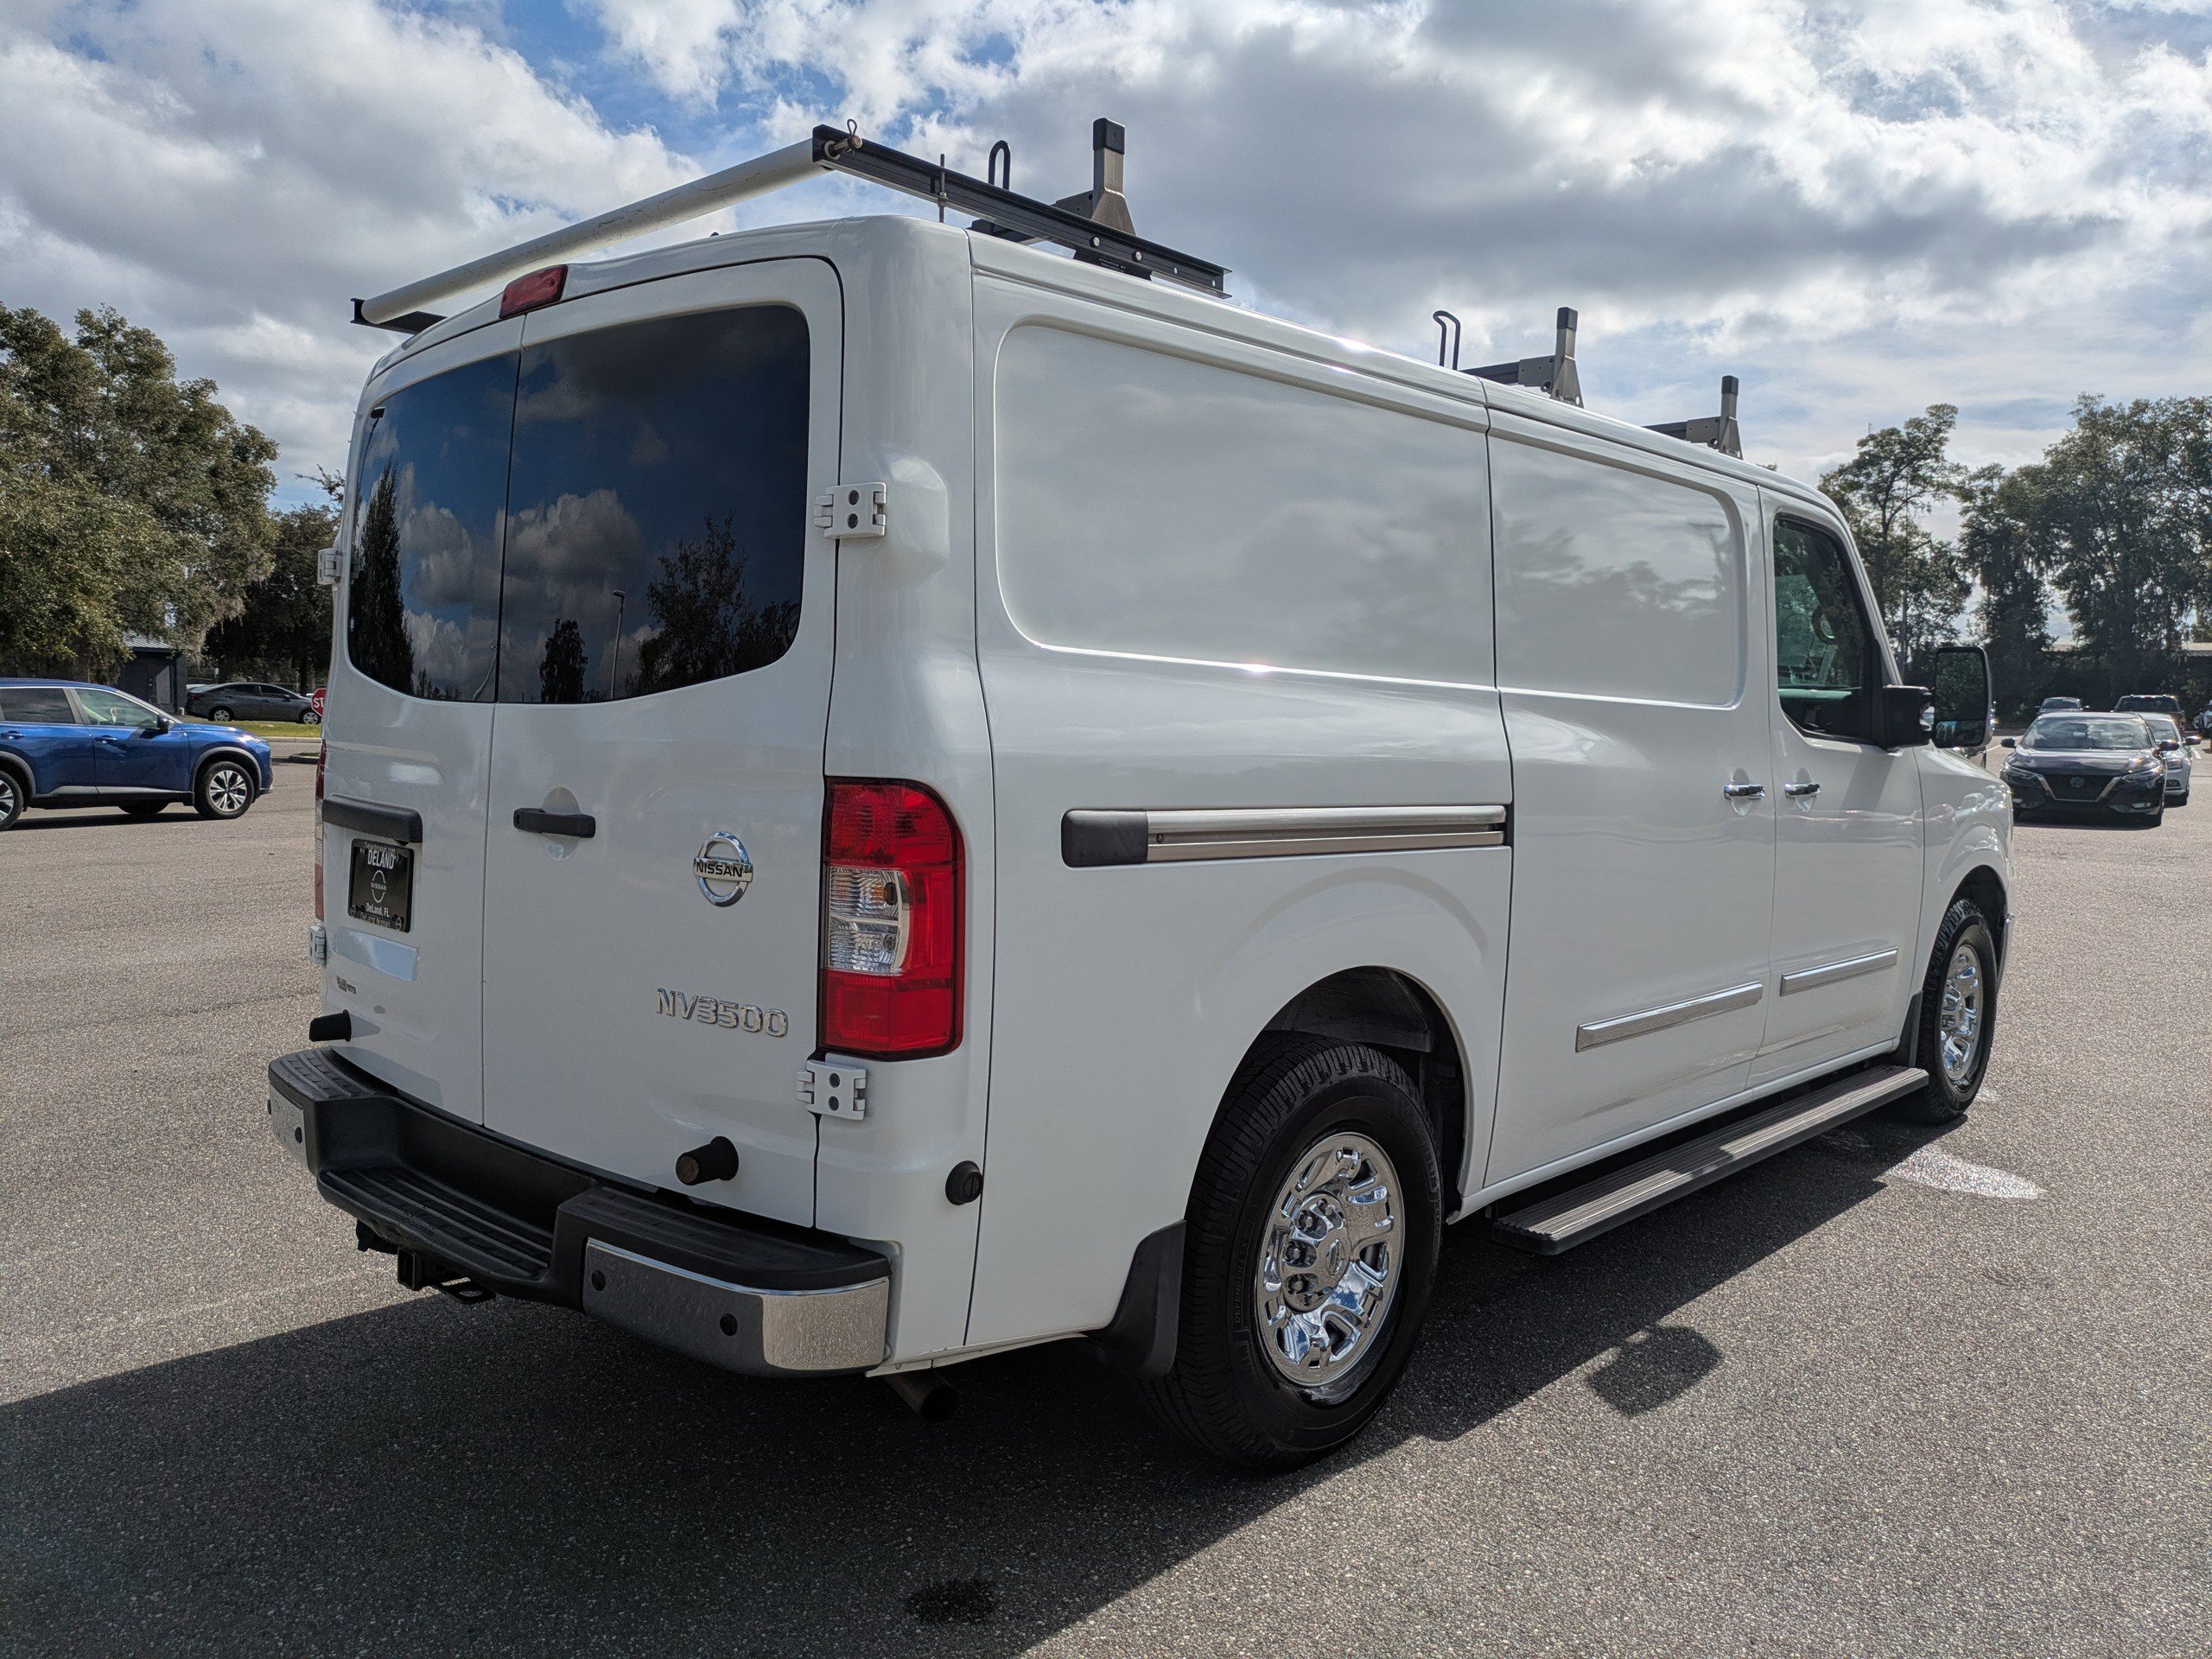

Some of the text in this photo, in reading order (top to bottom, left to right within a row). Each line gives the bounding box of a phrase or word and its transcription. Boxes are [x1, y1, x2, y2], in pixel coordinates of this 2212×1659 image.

[314, 697, 324, 708] ST
[367, 849, 395, 869] DELAND
[696, 862, 743, 878] NISSAN
[371, 882, 386, 891] NISSAN
[384, 906, 390, 918] FL
[656, 988, 788, 1037] NV3500
